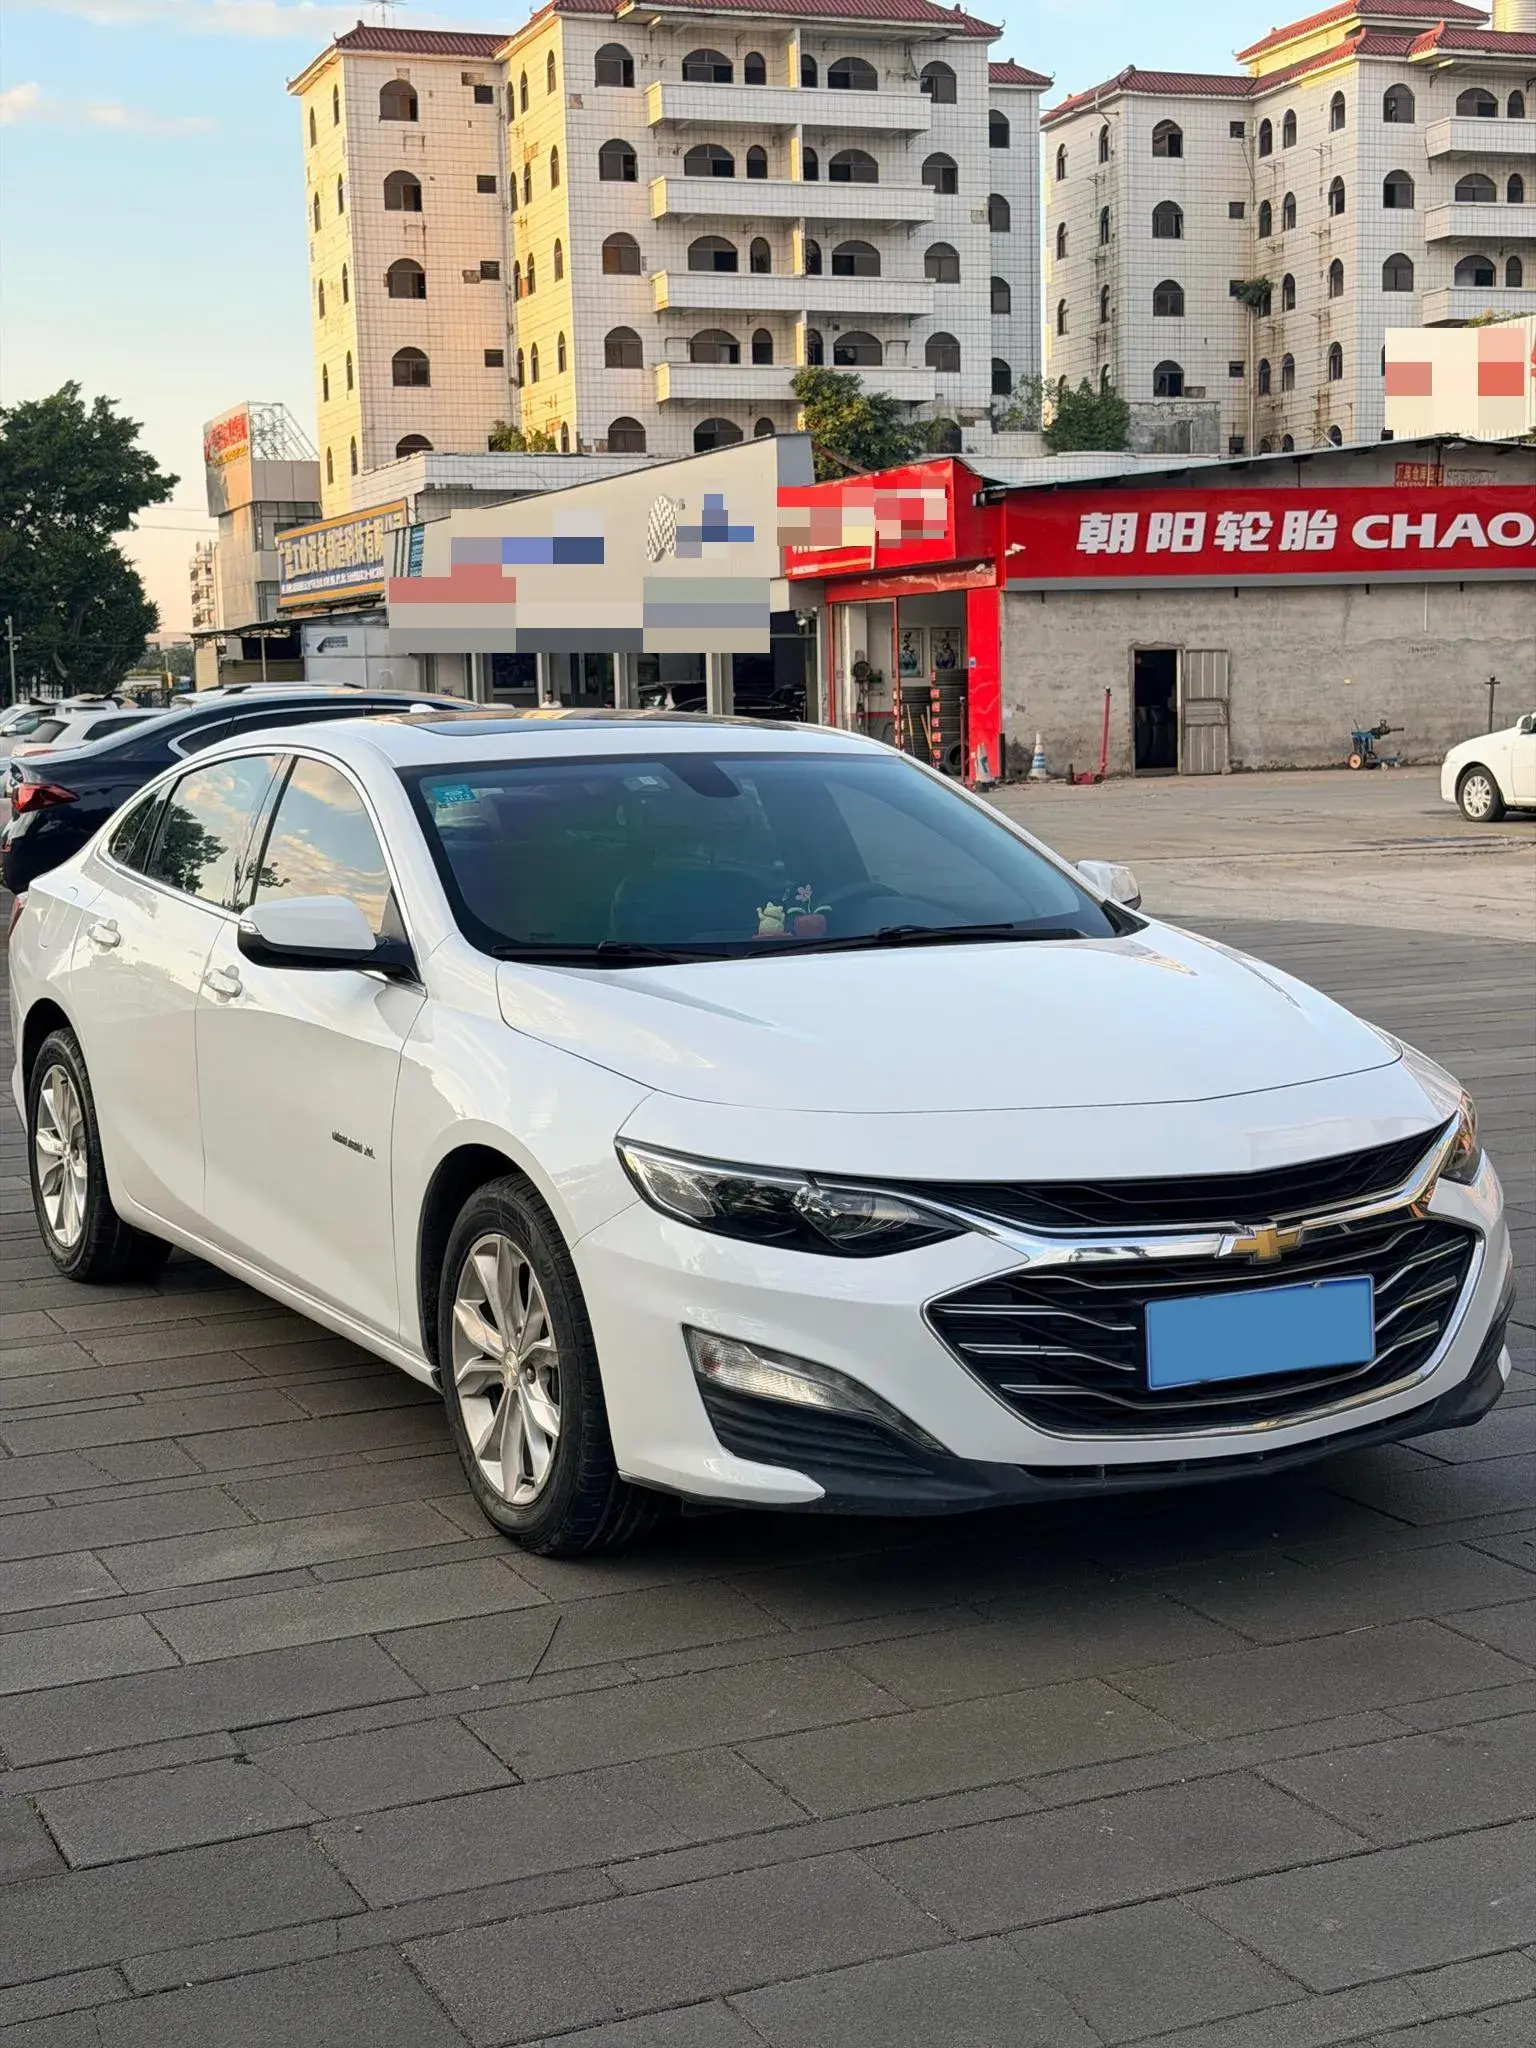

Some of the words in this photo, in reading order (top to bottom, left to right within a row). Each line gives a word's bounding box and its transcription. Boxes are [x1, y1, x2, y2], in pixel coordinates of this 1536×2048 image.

[1076, 509, 1338, 554] 朝阳轮胎
[1351, 511, 1536, 550] CHAO
